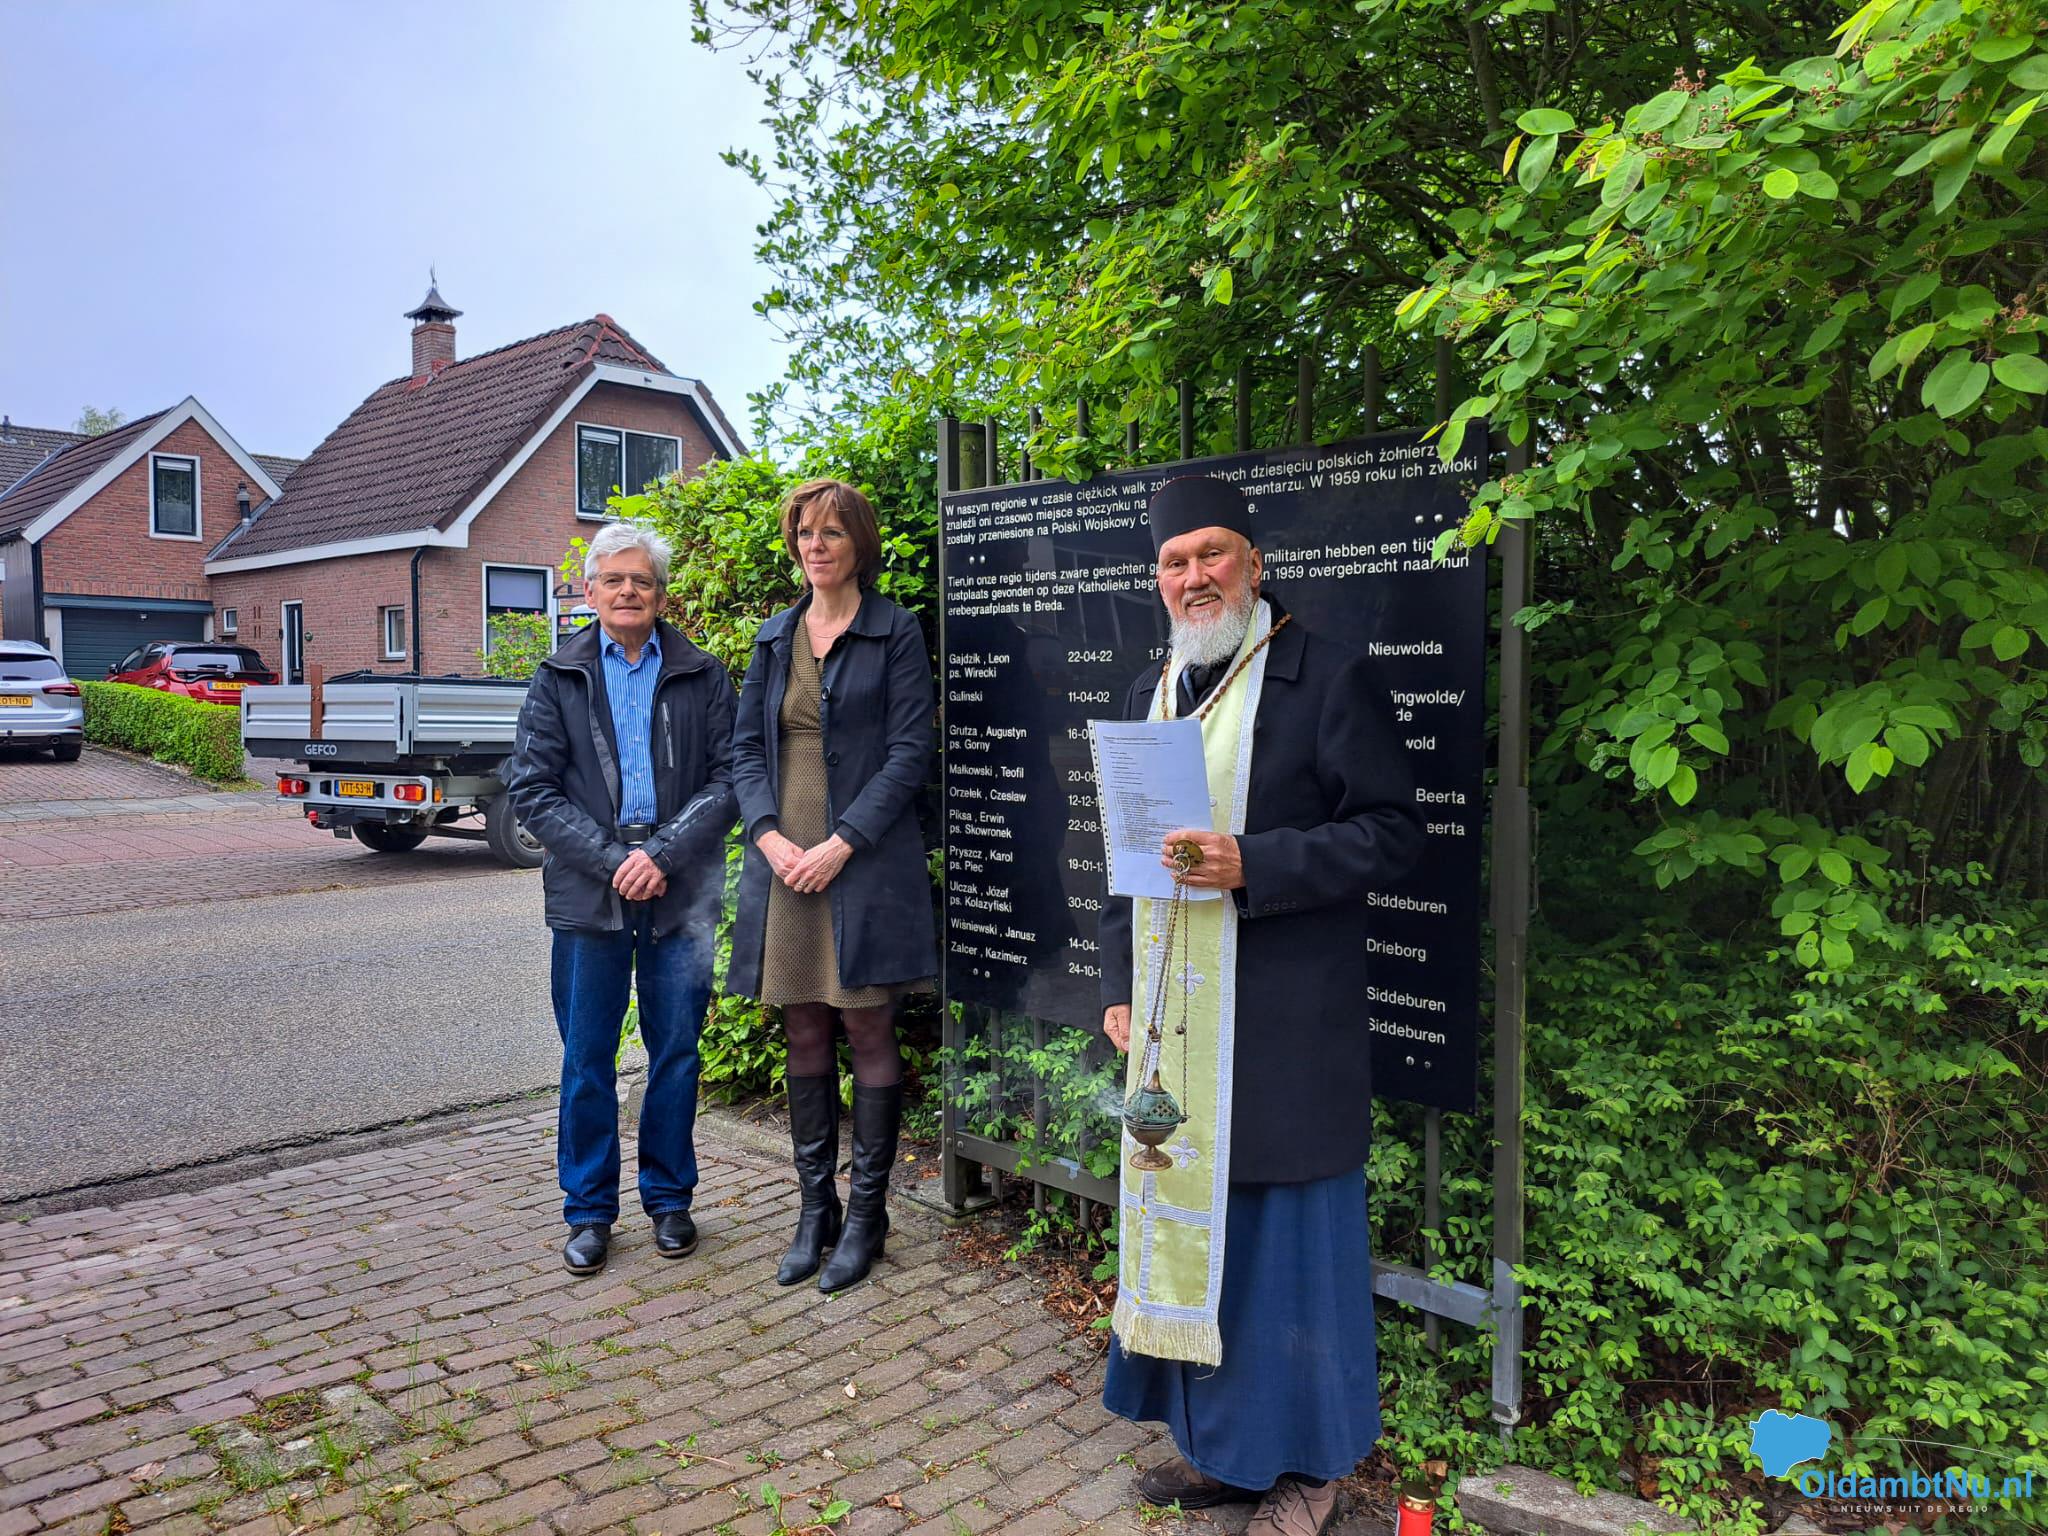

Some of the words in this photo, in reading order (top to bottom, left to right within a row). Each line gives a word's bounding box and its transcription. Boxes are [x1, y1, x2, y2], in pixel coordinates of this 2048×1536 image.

[945, 504, 954, 516] W
[957, 503, 989, 516] naszym
[991, 498, 1027, 512] regionie
[1030, 497, 1038, 506] w
[1042, 490, 1073, 505] czasie
[1122, 480, 1146, 495] walk
[1250, 458, 1312, 480] dziesięciu
[1317, 450, 1373, 472] polskich
[979, 515, 991, 526] oni
[994, 514, 1033, 526] czasowo
[1036, 508, 1073, 521] miejsce
[1076, 500, 1131, 518] spoczynku
[1134, 499, 1147, 509] na
[1309, 474, 1323, 488] W
[1329, 471, 1360, 486] 1959
[1365, 466, 1396, 482] roku
[1401, 462, 1422, 479] ich
[979, 527, 1034, 543] przeniesione
[1037, 526, 1048, 536] na
[1052, 518, 1081, 534] Polski
[1085, 516, 1136, 532] Wojskowy
[977, 576, 997, 586] onze
[1000, 572, 1022, 585] regio
[1025, 569, 1057, 584] tijdens
[1060, 569, 1089, 579] zware
[1093, 563, 1145, 580] gevechten
[1265, 545, 1320, 564] militairen
[1325, 541, 1375, 559] hebben
[1380, 543, 1407, 554] een
[947, 589, 989, 601] rustplaats
[991, 586, 1034, 600] gevonden
[1036, 587, 1048, 597] op
[1052, 584, 1075, 595] deze
[1078, 578, 1131, 593] Katholieke
[1275, 565, 1303, 580] 1959
[1309, 559, 1398, 578] overgebracht
[1403, 559, 1435, 571] naar
[948, 602, 1020, 617] erebegraafplaats
[1022, 602, 1031, 612] te
[1034, 600, 1065, 612] Breda.
[1368, 640, 1443, 656] Nieuwolda
[949, 653, 981, 665] Gajdzik
[988, 653, 1010, 664] Leon
[1067, 650, 1112, 663] 22-04-22
[949, 669, 961, 679] ps.
[964, 667, 997, 678] Wirecki
[0, 697, 29, 705] 01-ND
[1067, 691, 1110, 703] 11-04-02
[1390, 689, 1465, 707] ingwolde/
[1395, 708, 1413, 722] de
[949, 724, 977, 736] Grutza
[986, 725, 1027, 740] Augustyn
[1067, 728, 1089, 740] 16-0
[304, 744, 337, 756] GEFCO
[949, 740, 961, 751] ps.
[1405, 736, 1435, 750] wold
[1001, 766, 1024, 779] Teofil
[1067, 771, 1097, 783] 20-06
[340, 782, 371, 794] VTT-53-H
[1068, 794, 1099, 807] 12-12-1
[1416, 788, 1465, 805] Beerta
[949, 809, 972, 821] Piksa
[980, 811, 1005, 824] Erwin
[949, 825, 962, 835] ps.
[964, 823, 1012, 839] Skowronek
[1067, 819, 1103, 833] 22-08-
[1426, 822, 1465, 836] eerta
[949, 845, 982, 859] Pryszcz
[990, 849, 1013, 862] Karol
[949, 861, 962, 871] ps.
[964, 860, 983, 873] Piec
[1068, 858, 1103, 873] 19-01-1
[949, 880, 978, 895] Ulczak
[986, 885, 1009, 899] Józef
[949, 896, 962, 906] ps.
[1068, 896, 1103, 911] 30-03-
[1367, 892, 1447, 914] Siddeburen
[1004, 926, 1036, 942] Janusz
[1068, 937, 1099, 953] 14-04-
[1366, 938, 1427, 962] Drieborg
[951, 941, 978, 955] Zalcer
[985, 946, 1028, 965] Kazimierz
[1068, 961, 1102, 978] 24-10-1
[1366, 986, 1446, 1013] Siddeburen
[1368, 1017, 1446, 1045] Siddeburen
